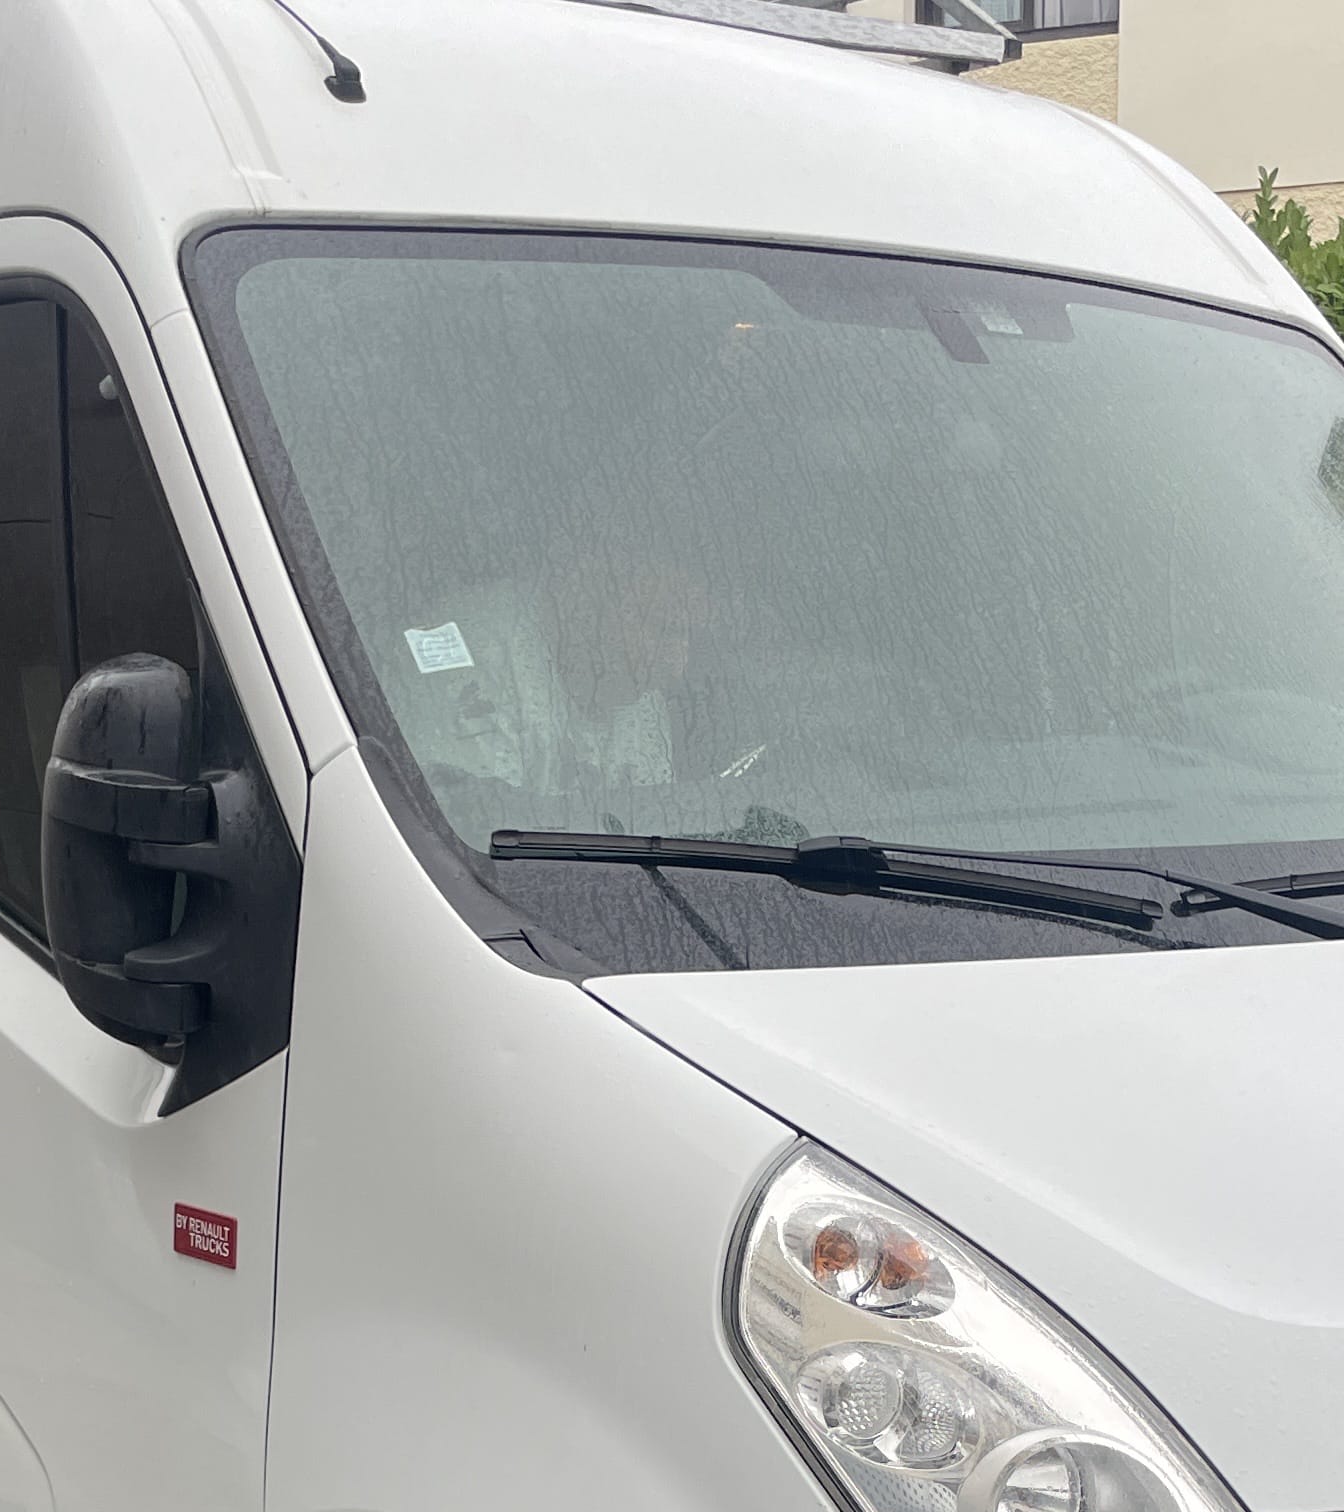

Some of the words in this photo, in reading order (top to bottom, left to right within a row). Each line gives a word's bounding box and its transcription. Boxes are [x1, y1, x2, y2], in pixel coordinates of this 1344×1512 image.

[176, 1213, 188, 1230] BY
[189, 1217, 230, 1242] RENAULT
[189, 1232, 230, 1257] TRUCKS
